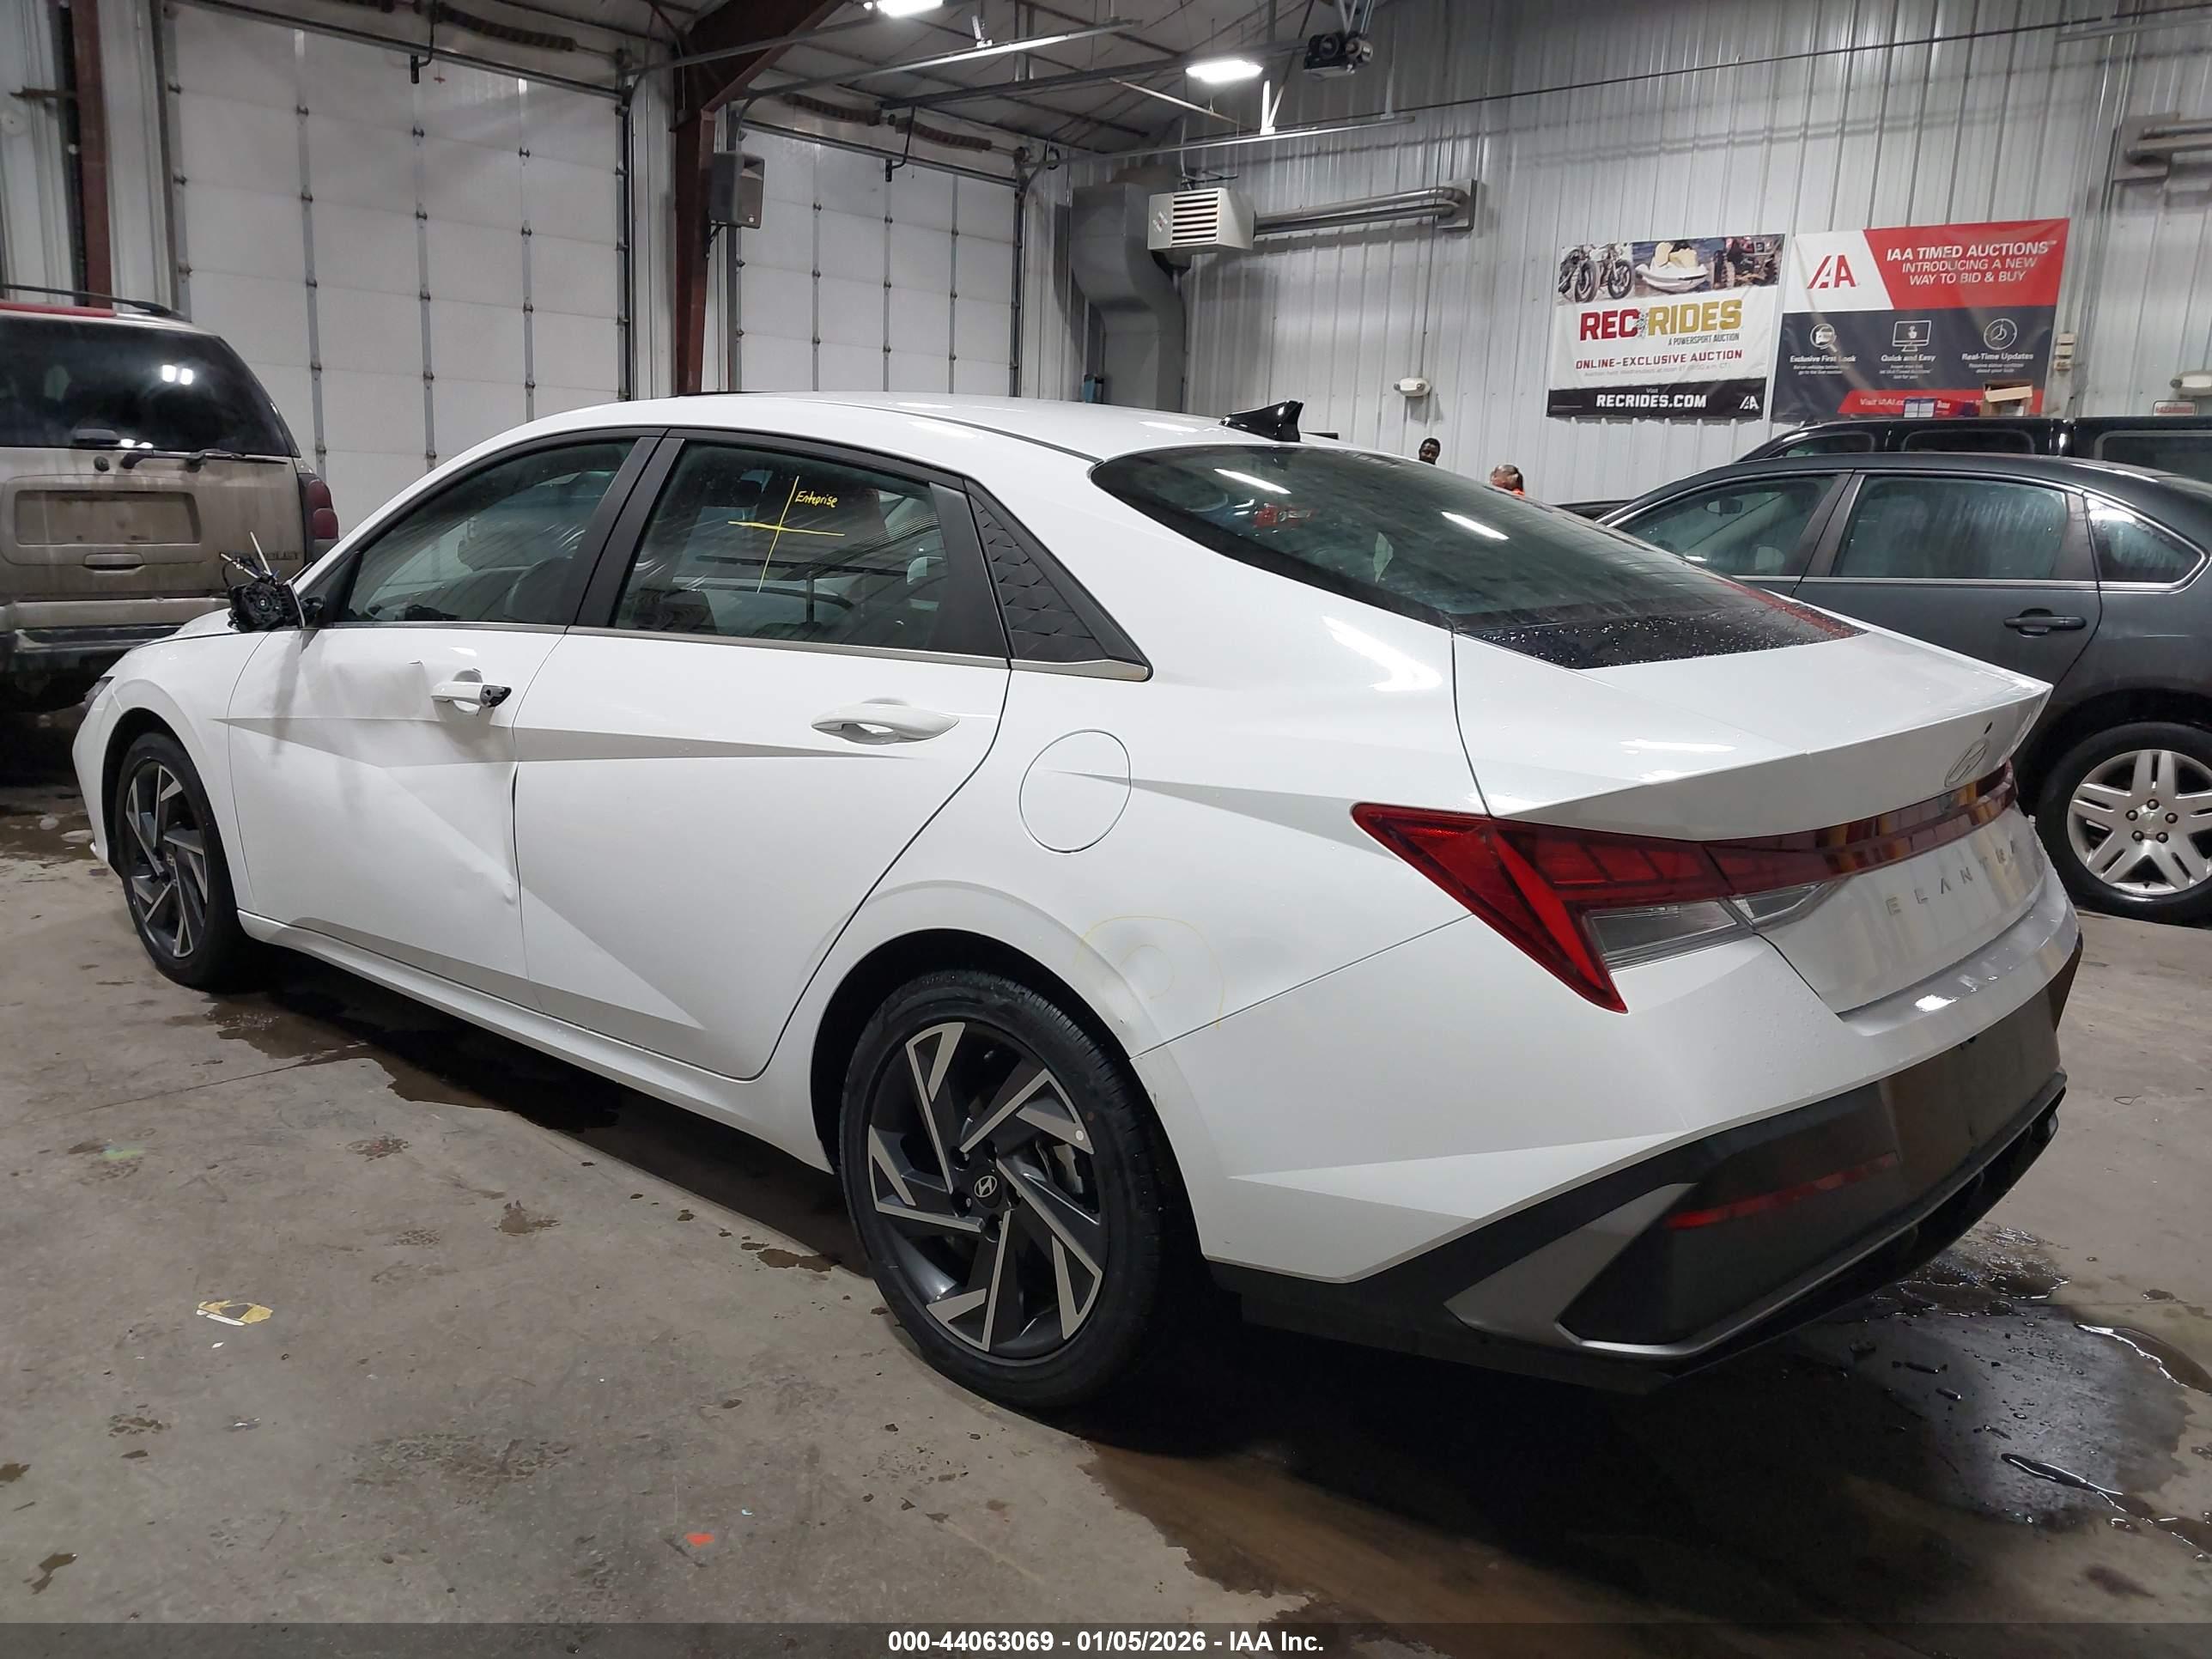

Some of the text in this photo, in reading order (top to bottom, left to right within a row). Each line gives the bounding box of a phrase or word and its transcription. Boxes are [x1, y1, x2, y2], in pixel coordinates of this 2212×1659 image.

[1887, 248, 1913, 261] IAA
[1917, 246, 1962, 258] TIMED
[1902, 257, 2039, 273] INTRODUCING A NEW
[1910, 270, 2027, 286] WAY TO BID & BUY
[1580, 299, 1743, 341] REC RIDES
[1673, 335, 1712, 345] POWERSPORT
[1713, 332, 1740, 343] AUCTION
[1576, 353, 1687, 370] ONLINE-EXCLUSIVE
[1690, 349, 1743, 362] AUCTION
[1918, 354, 1936, 362] Easy
[1596, 395, 1706, 408] RECRIDES.COM
